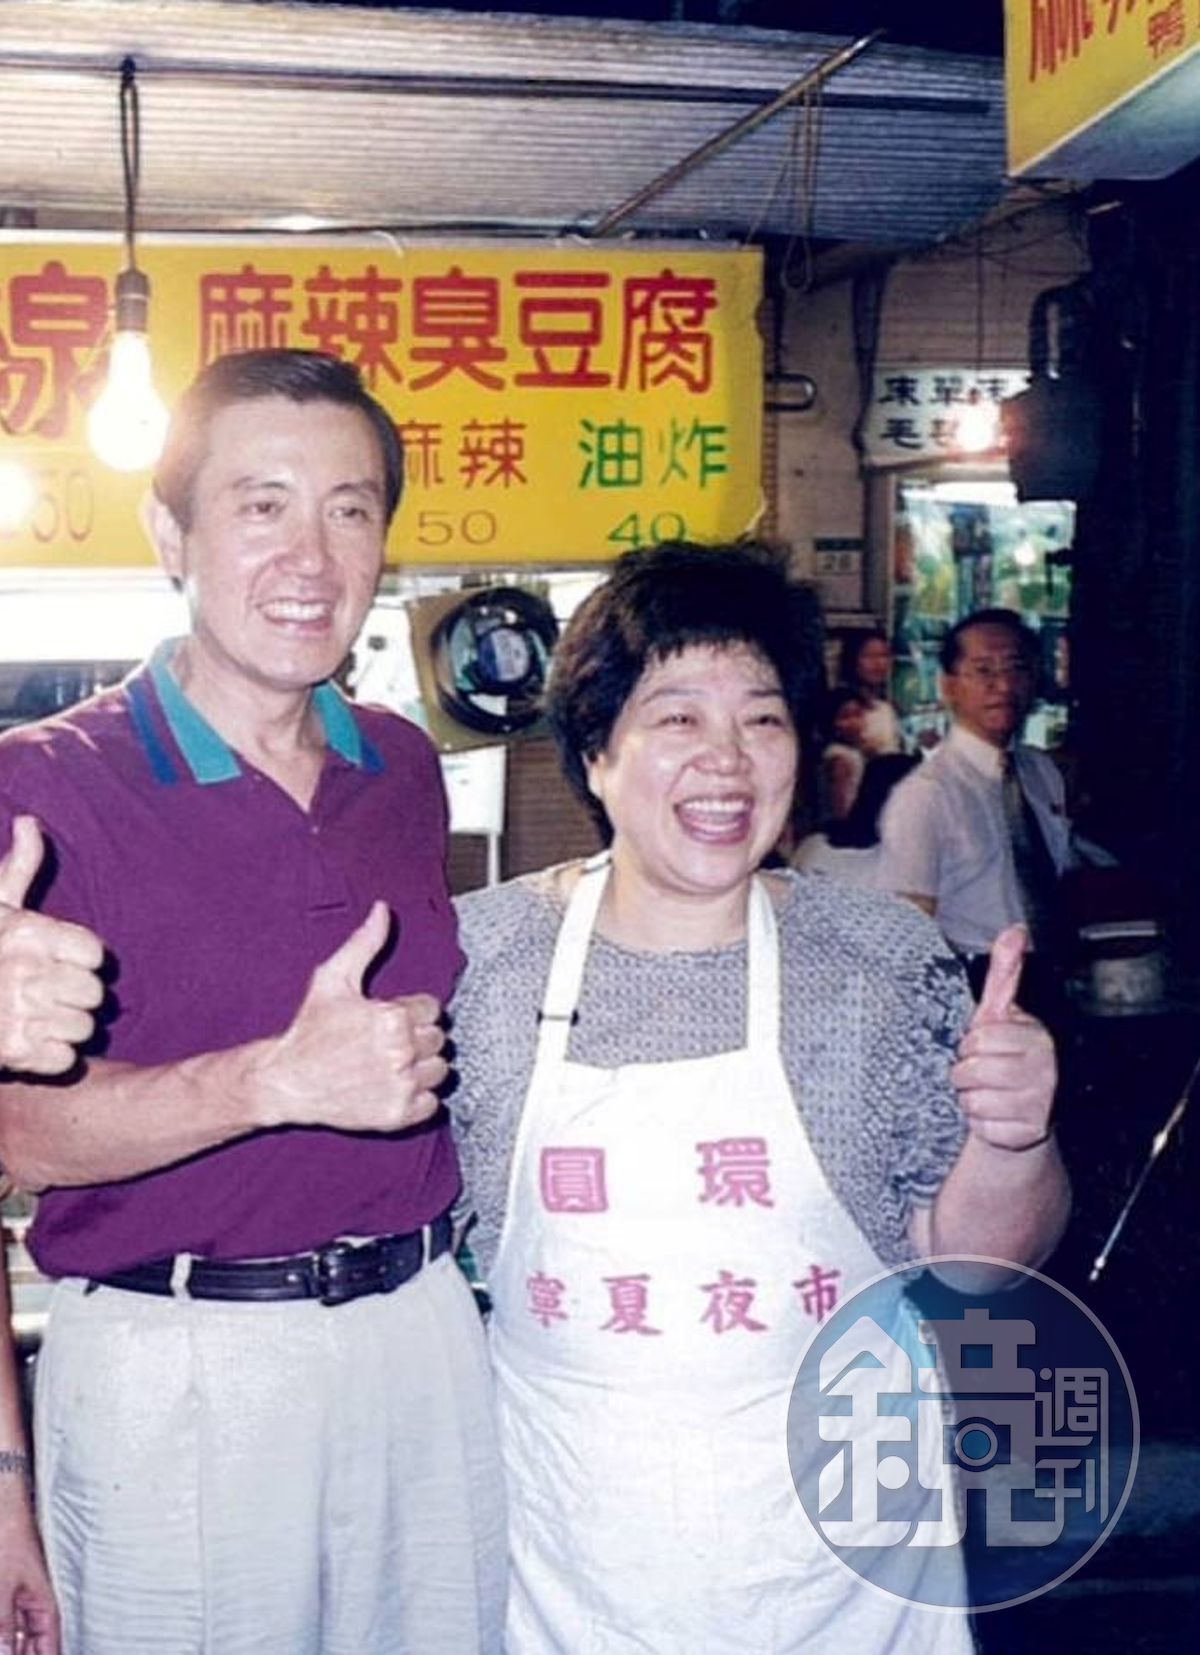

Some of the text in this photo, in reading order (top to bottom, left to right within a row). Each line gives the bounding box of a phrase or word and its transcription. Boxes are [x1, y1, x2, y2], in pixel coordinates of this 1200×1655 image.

[198, 264, 716, 393] 麻辣臭豆腐
[578, 417, 728, 490] 油炸
[417, 509, 687, 548] 50 40
[539, 1137, 775, 1214] 圓環
